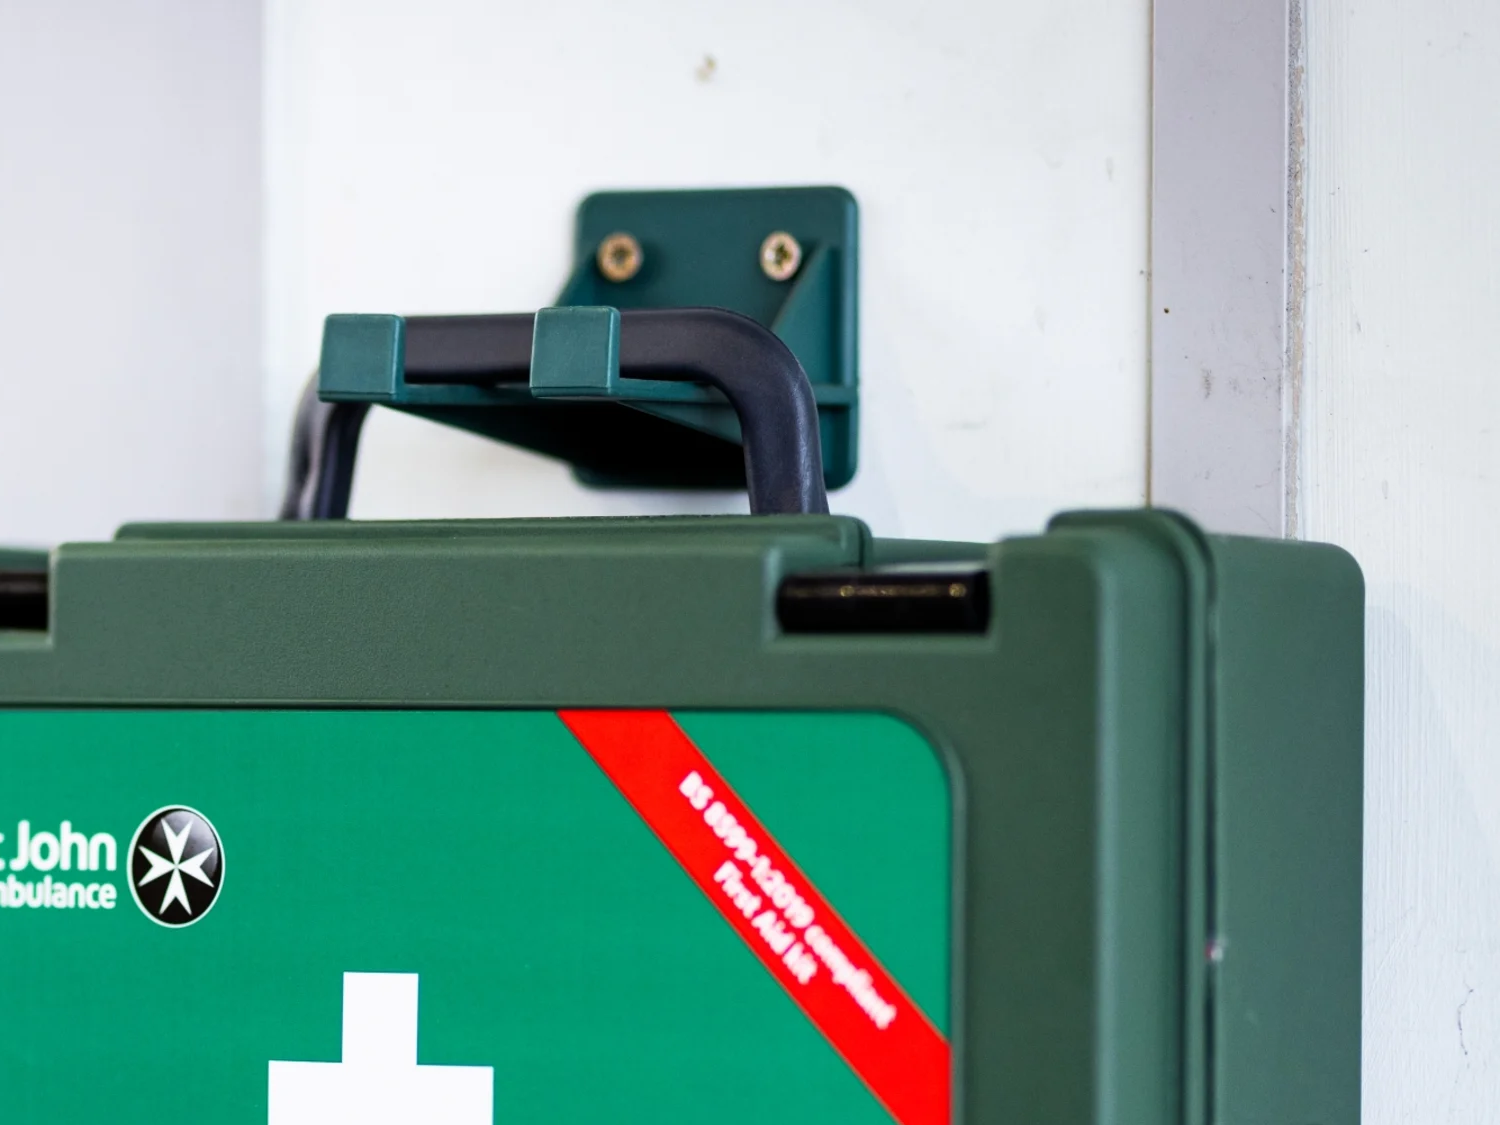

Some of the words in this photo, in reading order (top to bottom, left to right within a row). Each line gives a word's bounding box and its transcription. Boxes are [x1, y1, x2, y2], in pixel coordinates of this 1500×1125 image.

[679, 771, 714, 810] BS
[9, 820, 117, 871] John
[713, 860, 762, 919] First
[751, 910, 796, 955] Aid
